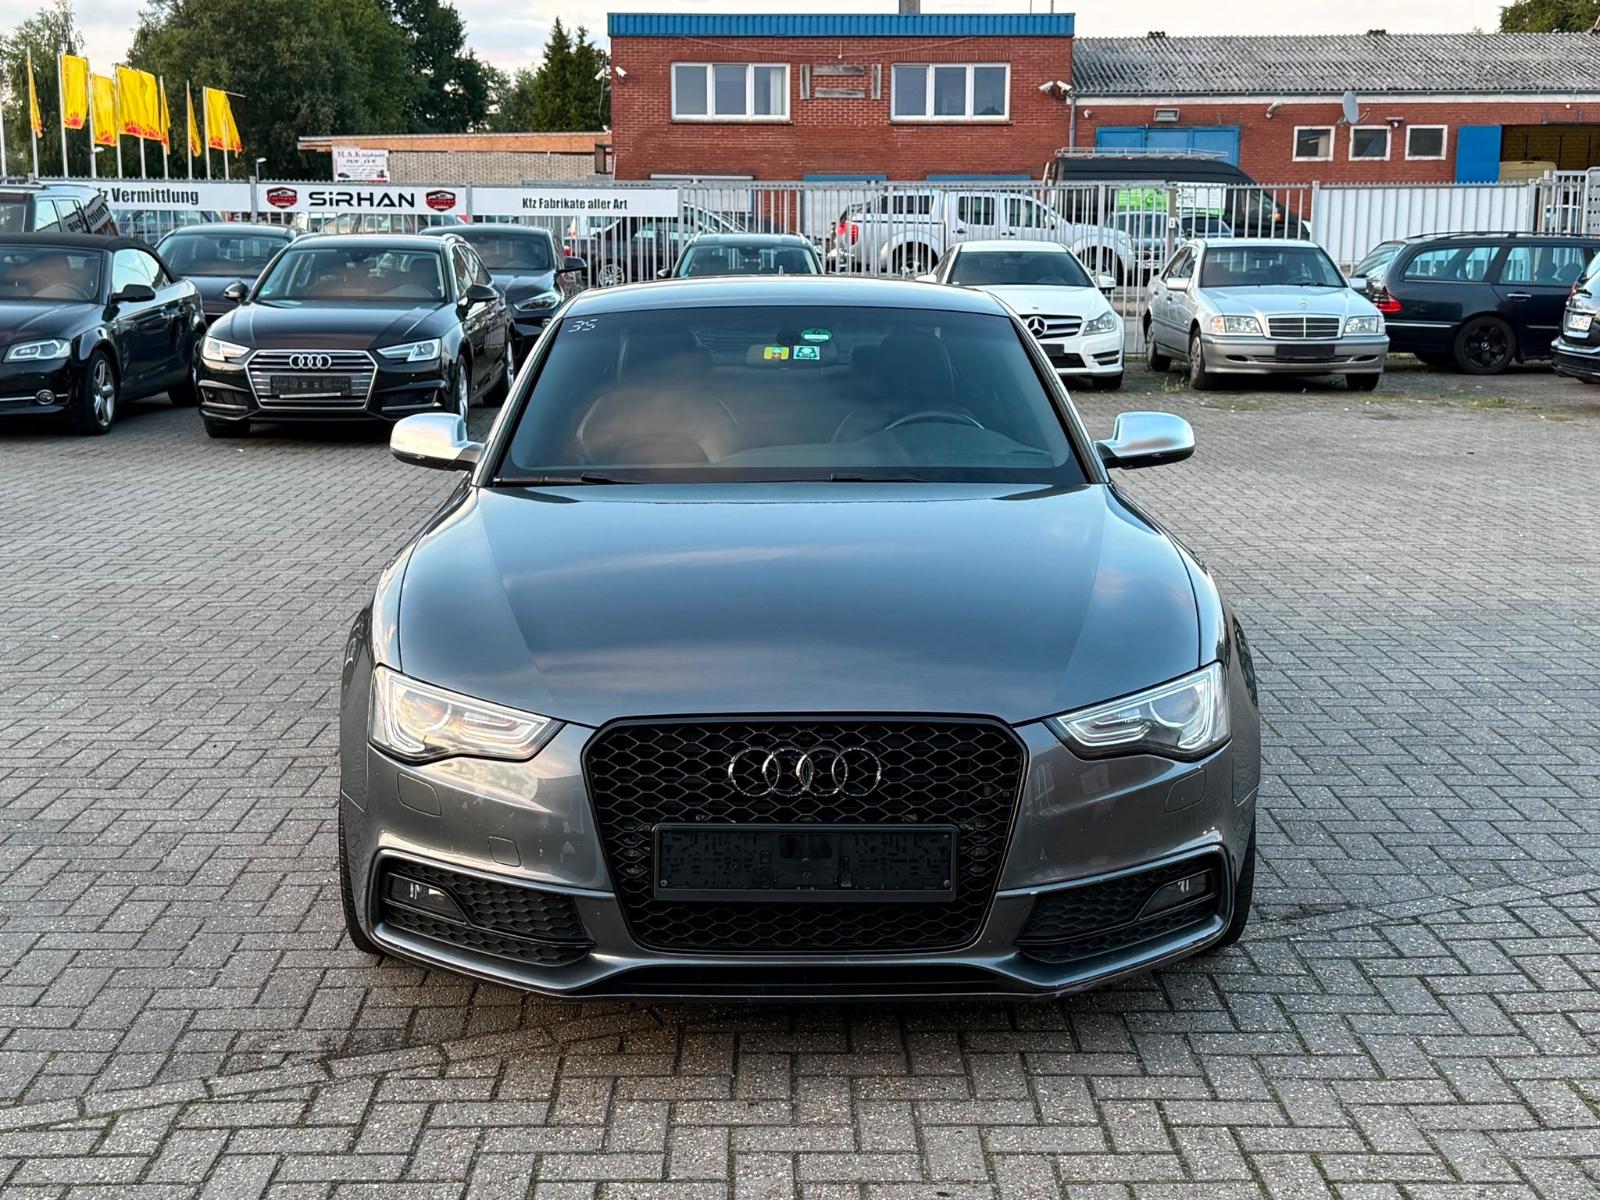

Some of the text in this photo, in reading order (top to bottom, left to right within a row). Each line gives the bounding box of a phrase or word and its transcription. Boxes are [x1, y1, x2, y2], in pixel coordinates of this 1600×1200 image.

[111, 188, 199, 205] Vermittlung
[522, 197, 628, 210] Kfz Fabrikate aller Art
[568, 318, 599, 333] 35
